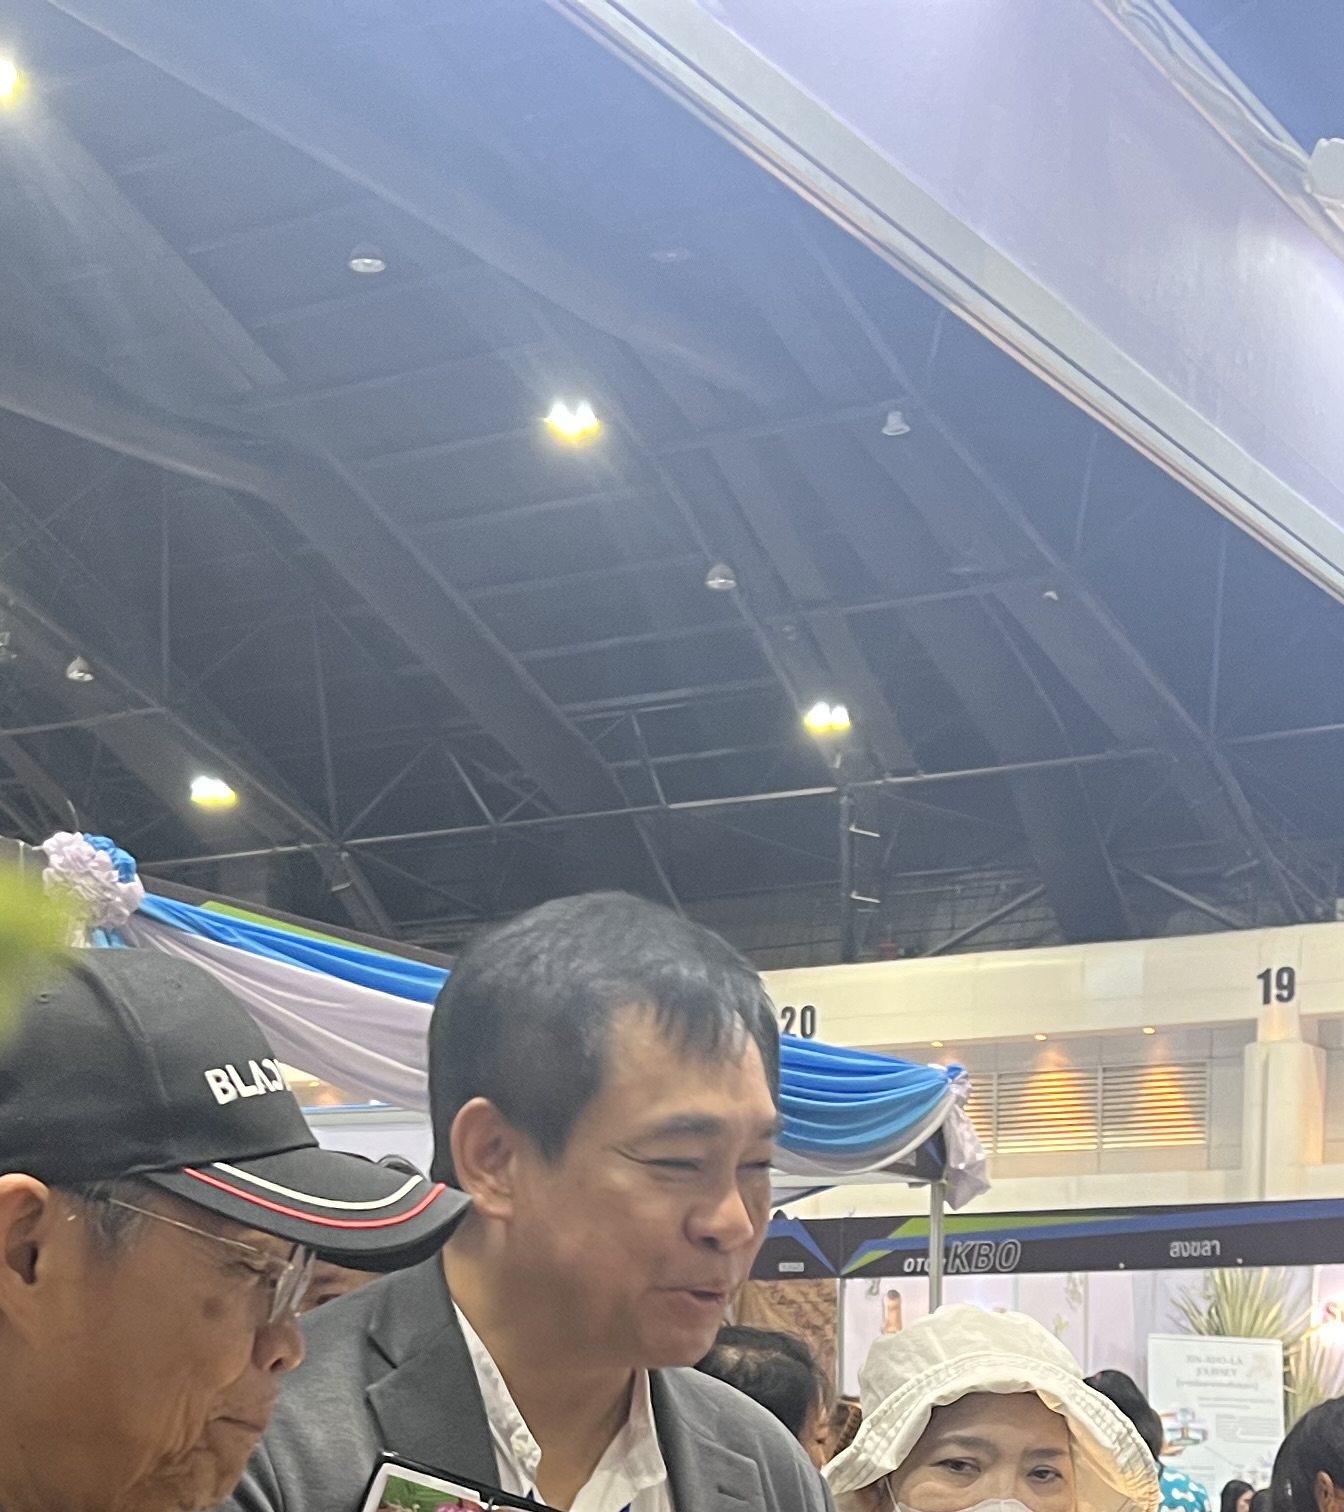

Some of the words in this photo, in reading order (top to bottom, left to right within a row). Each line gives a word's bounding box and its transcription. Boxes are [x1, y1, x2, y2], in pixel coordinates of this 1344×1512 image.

[1257, 966, 1296, 1005] 19
[781, 1005, 816, 1039] 20
[948, 1238, 1021, 1274] KBO
